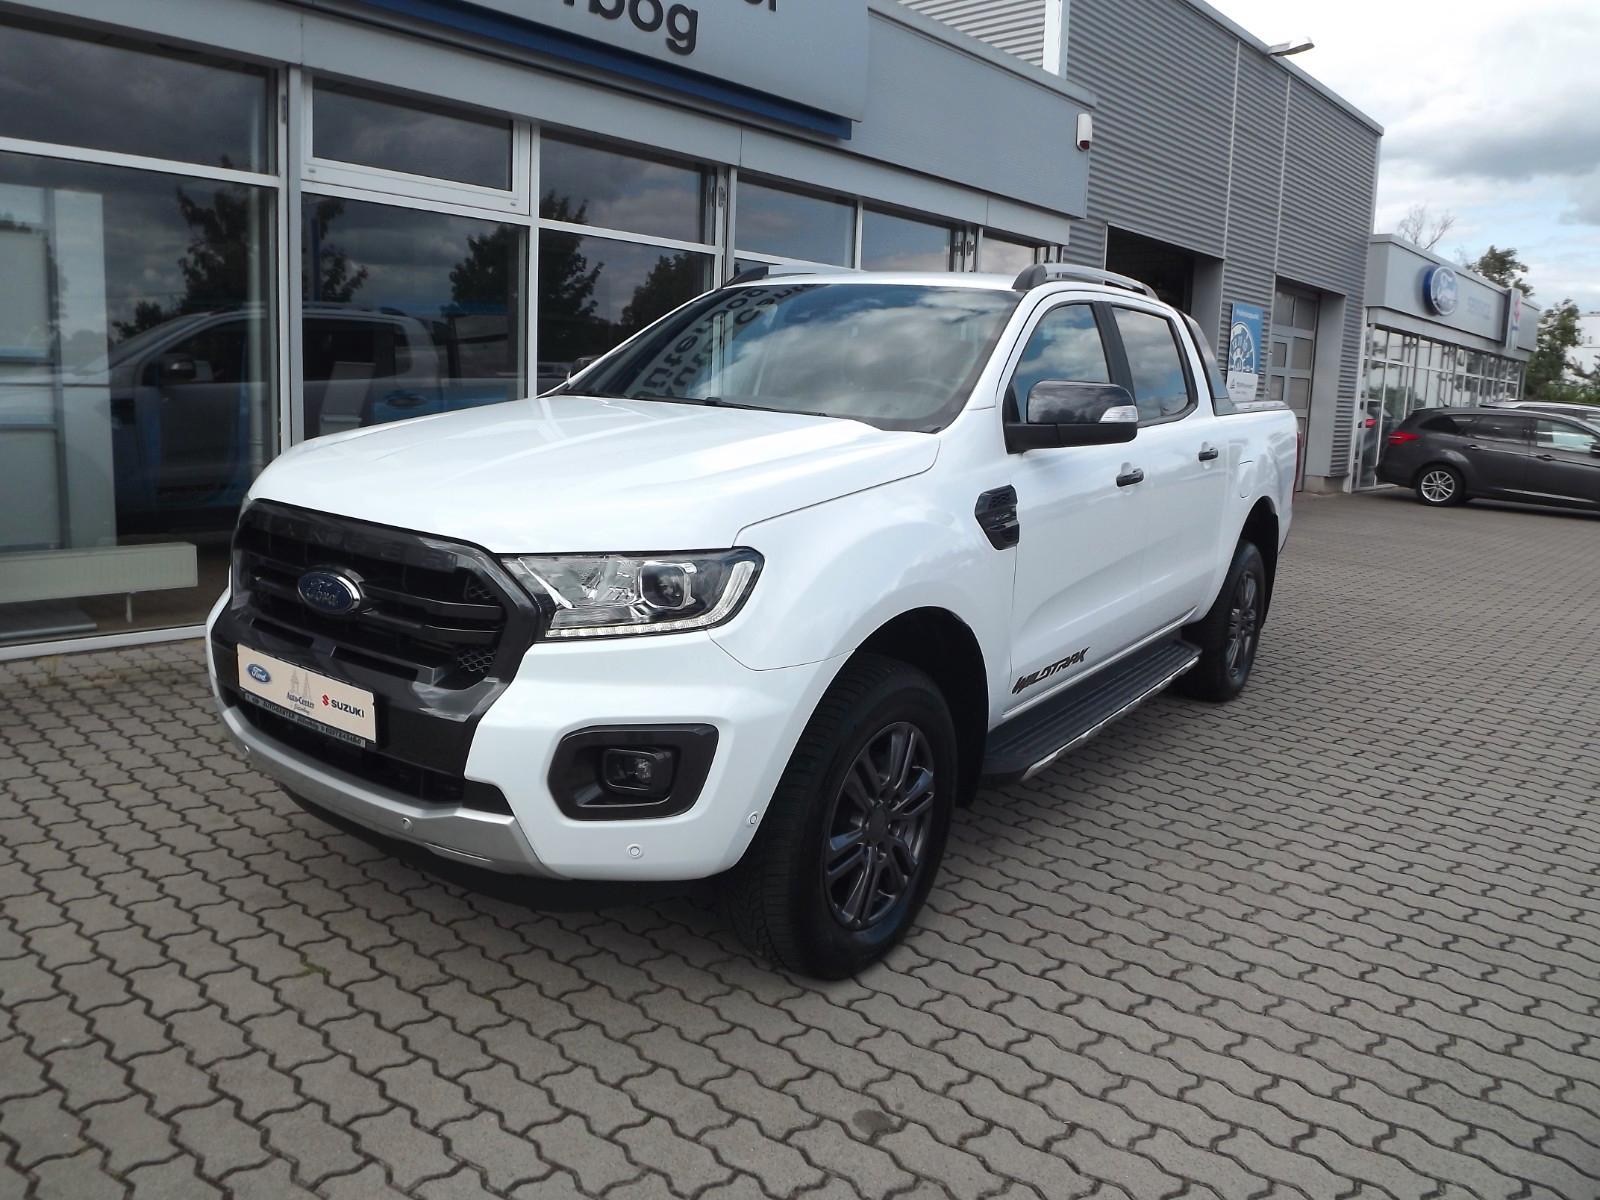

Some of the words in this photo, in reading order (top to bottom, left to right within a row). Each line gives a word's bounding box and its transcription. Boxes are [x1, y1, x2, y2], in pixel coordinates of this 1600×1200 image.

[250, 665, 268, 682] Ford
[1010, 646, 1090, 694] WILDTRAK
[331, 699, 365, 718] SUZUKI
